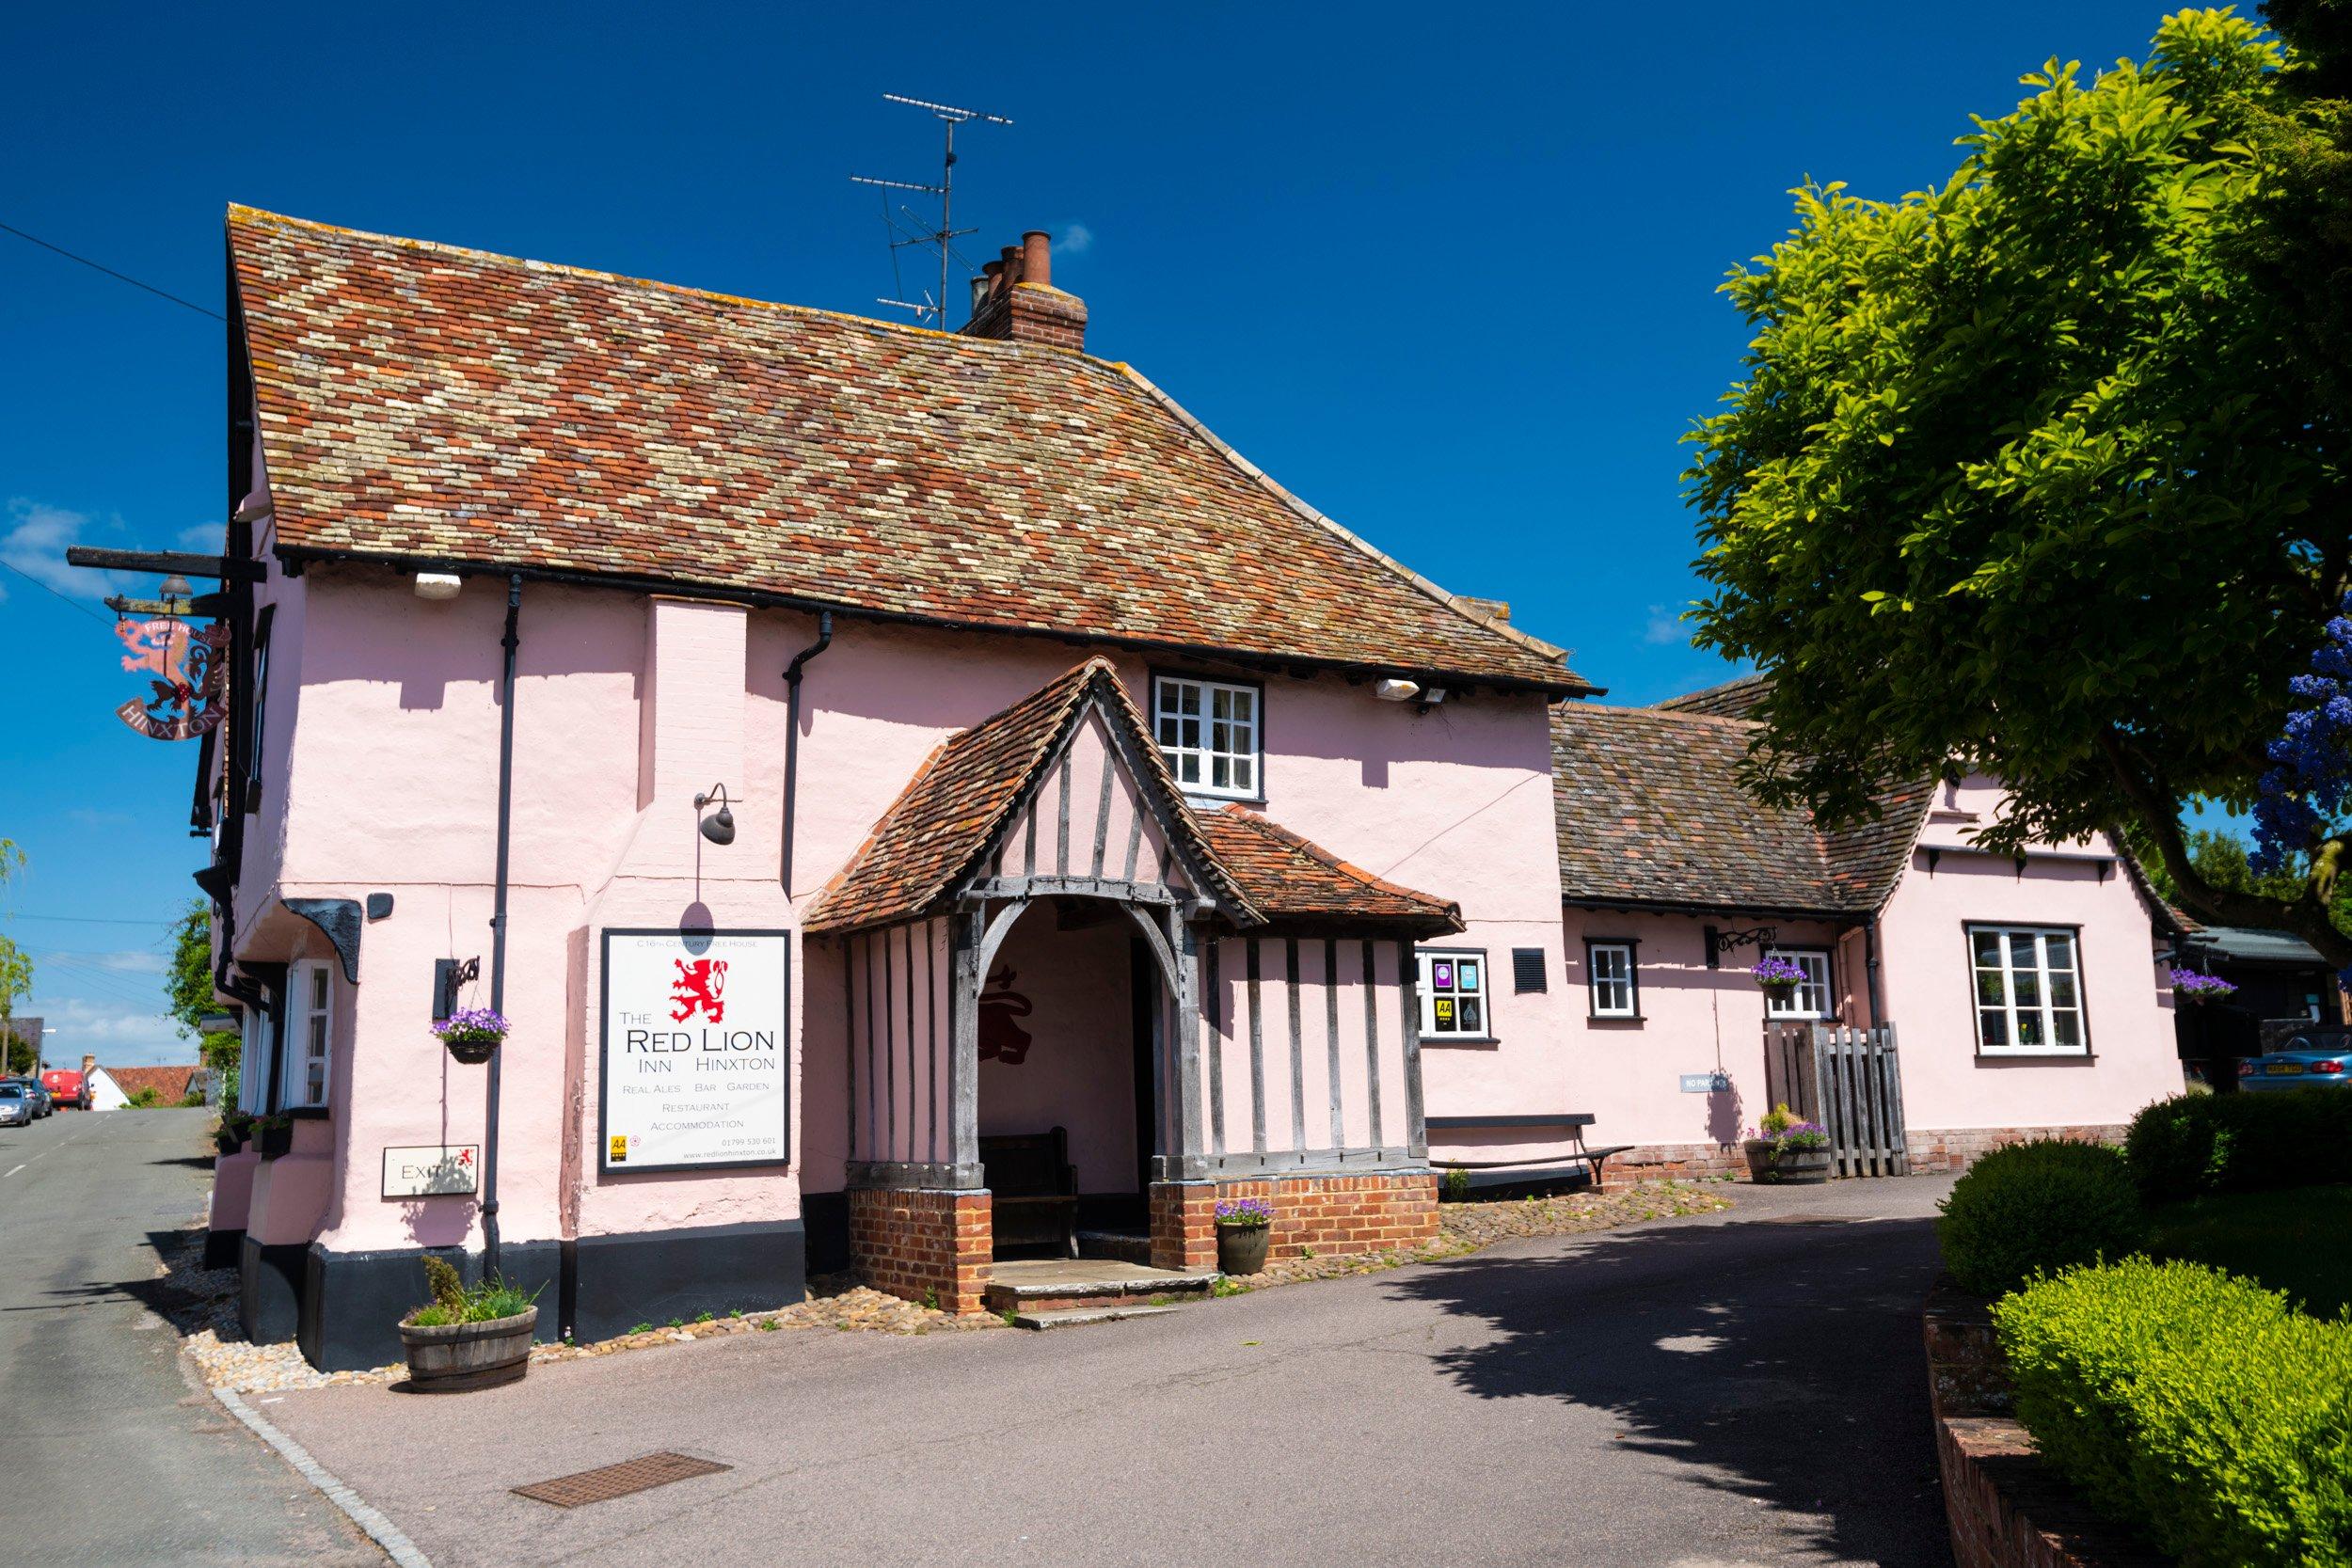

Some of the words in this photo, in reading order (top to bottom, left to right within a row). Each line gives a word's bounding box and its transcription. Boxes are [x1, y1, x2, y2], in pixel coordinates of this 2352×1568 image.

[144, 621, 175, 633] FREE
[121, 705, 222, 738] HINXTON
[666, 940, 705, 949] CENTURY
[707, 940, 727, 949] FREE
[729, 940, 758, 949] HOUSE
[1439, 1003, 1451, 1013] AA
[619, 1011, 652, 1025] THE
[627, 1029, 691, 1053] RED
[702, 1028, 774, 1052] LION
[639, 1058, 672, 1073] INN
[695, 1057, 775, 1071] HINXTON
[623, 1085, 650, 1095] REAL
[653, 1085, 681, 1094] ALES
[694, 1083, 717, 1092] BAR
[726, 1082, 770, 1092] GARDEN
[1686, 1078, 1696, 1087] NO
[662, 1102, 730, 1113] RESTAURANT
[650, 1119, 744, 1132] ACCOMMODATION
[612, 1139, 626, 1148] AA
[722, 1138, 745, 1147] 01799
[747, 1137, 761, 1146] 530
[762, 1136, 776, 1145] 601
[683, 1147, 777, 1159] www.redlionhinxton.co.uk
[402, 1164, 442, 1179] EXIT
